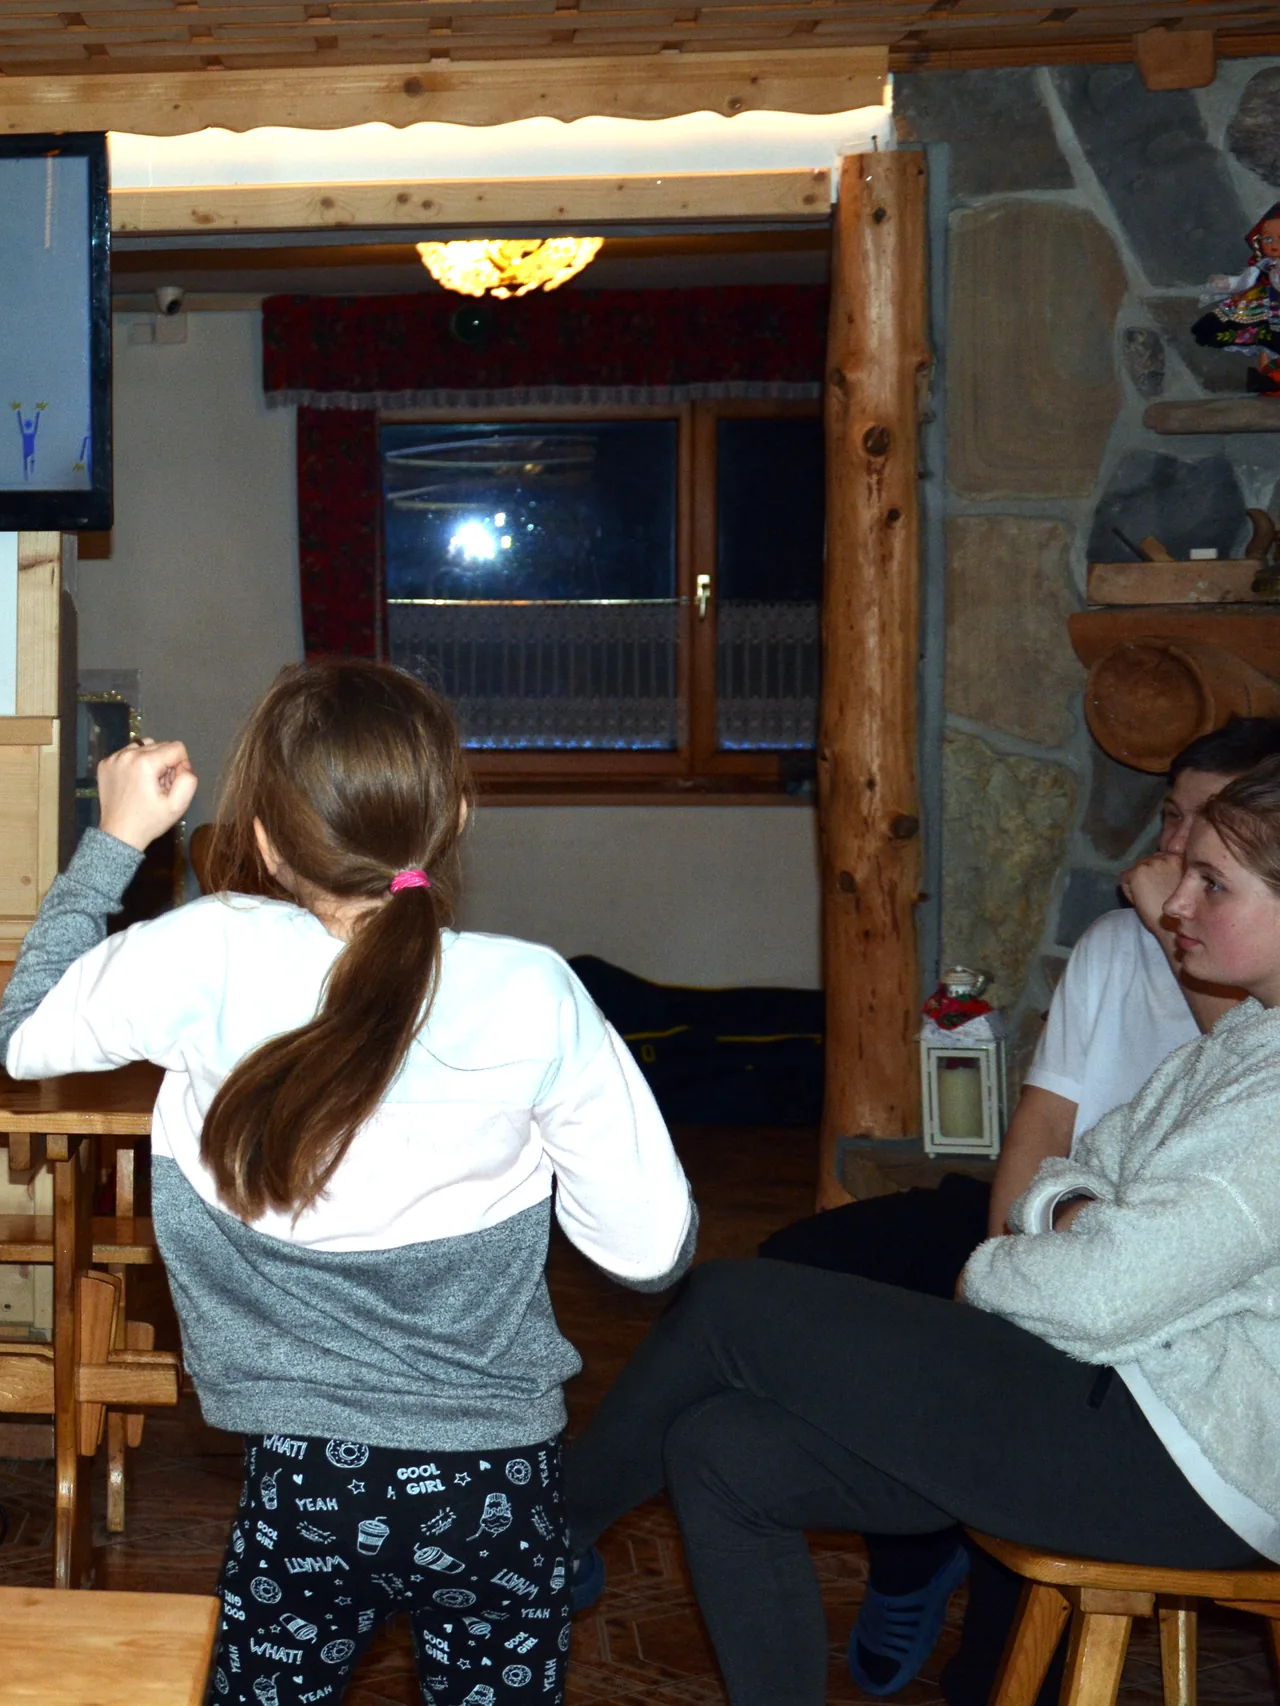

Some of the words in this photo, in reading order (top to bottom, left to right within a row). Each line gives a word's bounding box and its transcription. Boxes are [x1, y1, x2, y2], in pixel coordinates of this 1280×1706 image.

[263, 1434, 308, 1460] WHAT!
[396, 1463, 441, 1481] COOL
[537, 1450, 550, 1488] YEAH
[406, 1479, 446, 1495] GIRL
[295, 1497, 338, 1511] YEAH
[257, 1520, 278, 1540] COOL
[256, 1532, 274, 1550] GIRL
[284, 1555, 349, 1574] WHAT!
[490, 1568, 540, 1600] WHAT!
[224, 1602, 246, 1621] COOL
[358, 1608, 375, 1634] YEAH
[521, 1608, 550, 1619] YEAH
[423, 1630, 450, 1652] COOL
[504, 1631, 529, 1649] COOL
[517, 1637, 539, 1655] GIRL
[228, 1644, 242, 1673] YEAH
[250, 1637, 304, 1665] WHAT!
[425, 1644, 450, 1665] GIRL
[542, 1658, 557, 1692] YEAH
[298, 1685, 333, 1704] YEAH
